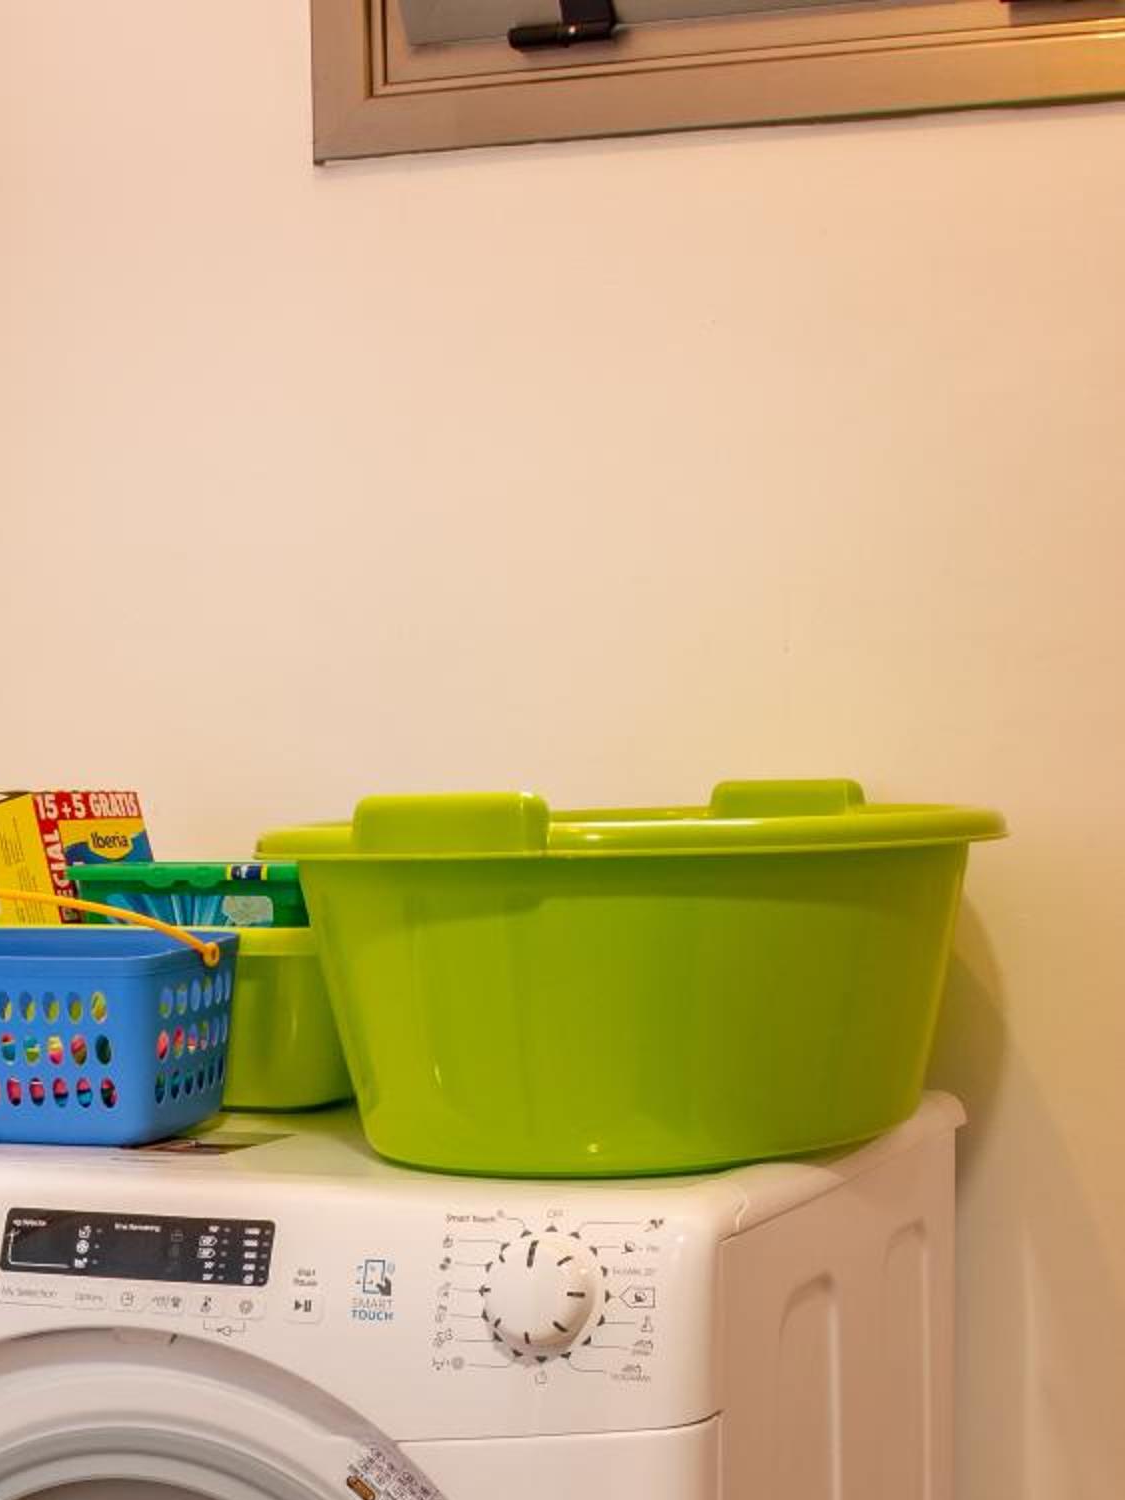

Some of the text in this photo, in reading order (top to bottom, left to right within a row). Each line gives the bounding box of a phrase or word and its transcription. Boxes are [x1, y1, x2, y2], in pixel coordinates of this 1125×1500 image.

[36, 793, 59, 820] 15
[72, 793, 86, 819] 5
[89, 792, 139, 818] GRATIS
[91, 832, 129, 849] Iberia
[352, 1297, 393, 1309] SMART
[351, 1309, 394, 1321] TOUCH
